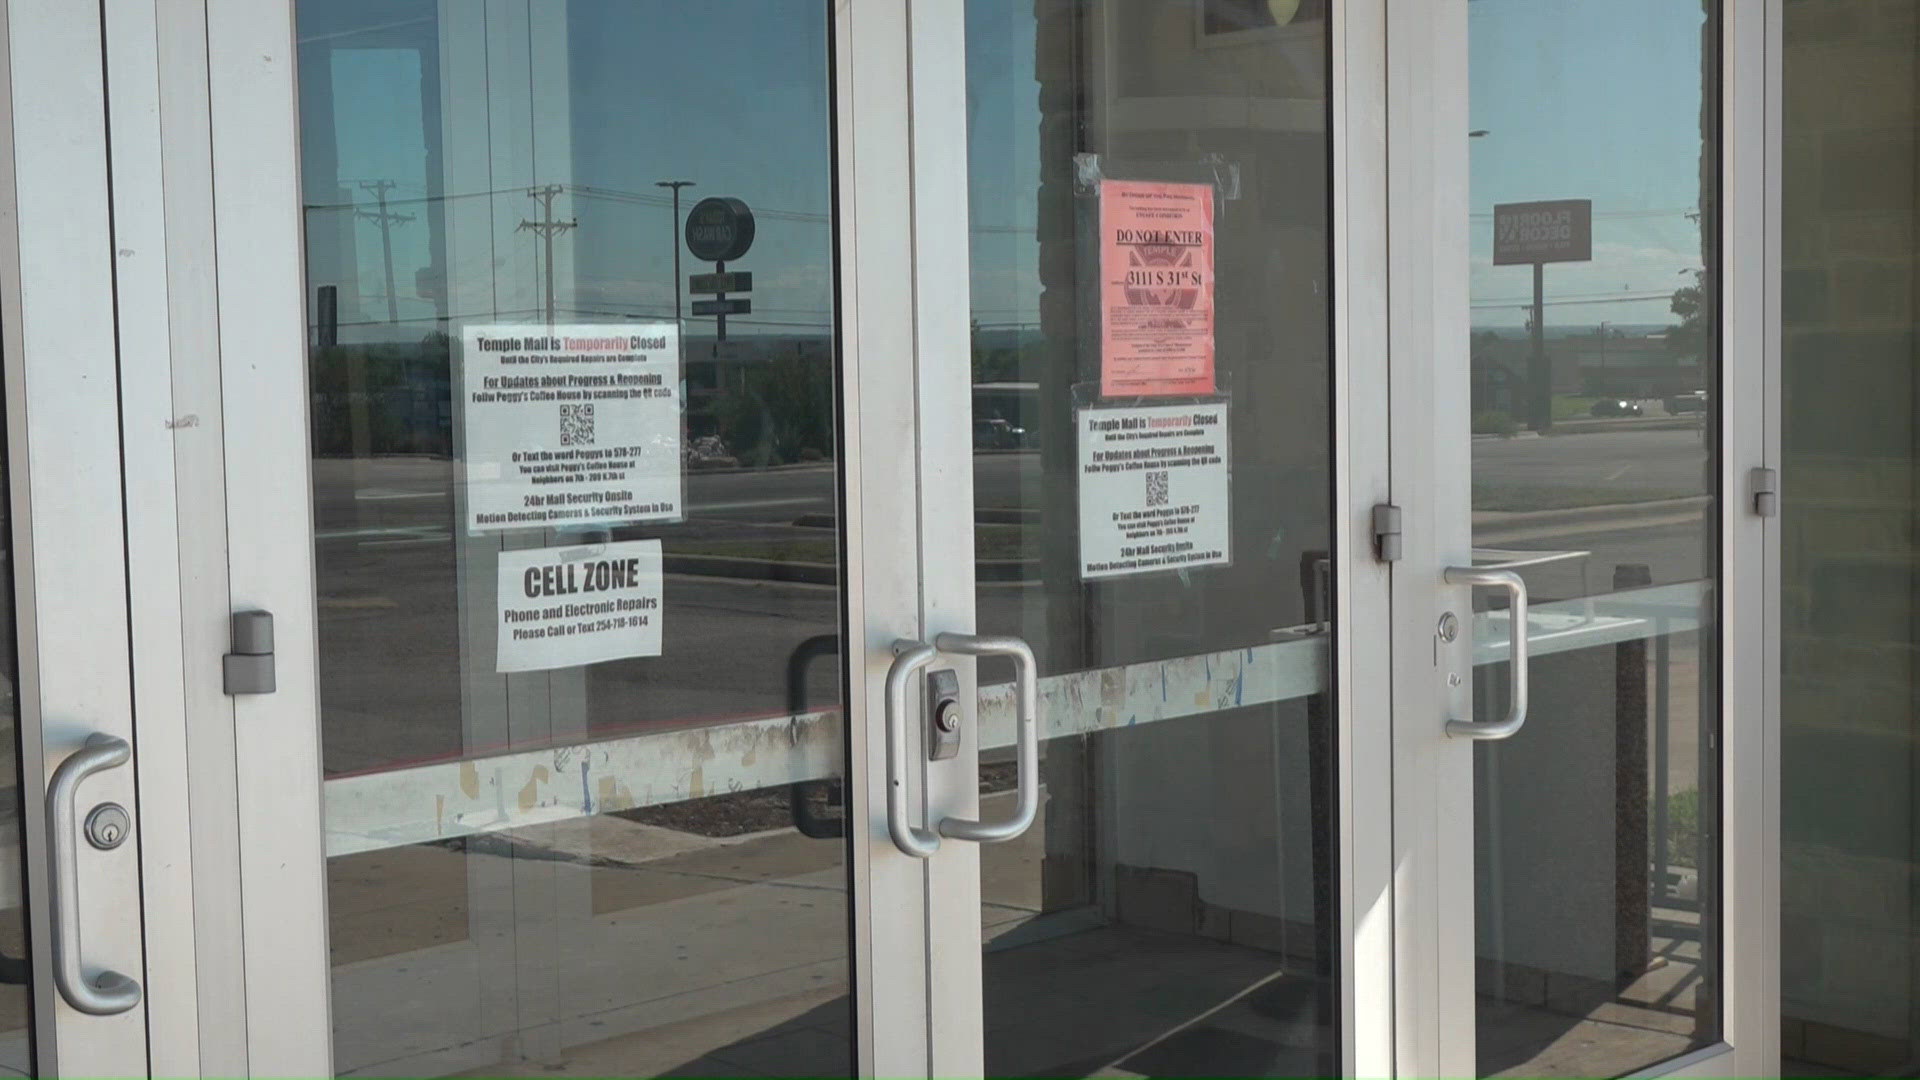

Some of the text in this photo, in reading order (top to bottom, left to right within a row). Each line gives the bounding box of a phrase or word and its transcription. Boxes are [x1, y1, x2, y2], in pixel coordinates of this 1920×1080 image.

[1116, 229, 1202, 243] DO NOT ENTER
[1129, 270, 1152, 285] 3111
[1157, 271, 1163, 285] S
[1168, 271, 1188, 285] 31st
[477, 336, 666, 353] Temple Mall is Temporarily Closed
[501, 355, 516, 364] Until
[518, 354, 529, 364] the
[530, 354, 548, 364] City's
[550, 354, 579, 364] Required
[581, 354, 605, 363] Repairs
[618, 353, 647, 363] Complete
[484, 373, 662, 388] For Updates about Progress & Reopening
[497, 391, 528, 403] Peggy's
[530, 390, 555, 401] Coffee
[557, 389, 582, 400] House
[583, 389, 592, 400] by
[593, 388, 628, 400] scanning
[630, 388, 641, 398] the
[654, 387, 671, 398] code
[1089, 414, 1218, 432] Temple Mall is Temporarily Closed
[512, 452, 521, 462] Or
[523, 451, 539, 461] Text
[541, 451, 553, 460] the
[554, 450, 574, 460] word
[575, 449, 603, 460] Peggys
[605, 448, 612, 458] to
[1093, 451, 1104, 461] For
[1105, 450, 1132, 460] Updates
[1133, 449, 1150, 458] about
[1151, 447, 1176, 457] Progress
[519, 465, 531, 474] You
[533, 465, 544, 473] can
[546, 464, 559, 472] visit
[586, 462, 607, 471] Coffee
[1161, 460, 1166, 468] by
[524, 490, 633, 507] 24hr Mall Security Onsite
[476, 502, 673, 524] Motion Detecting Cameras & Security System in Use
[1113, 512, 1119, 520] Or
[1120, 512, 1132, 520] Text
[1143, 510, 1155, 518] word
[1121, 547, 1135, 557] 24hr
[1137, 545, 1150, 556] Mall
[1151, 543, 1174, 553] Security
[1087, 563, 1108, 572] Motion
[1109, 560, 1136, 570] Detecting
[1167, 554, 1186, 563] Security
[524, 558, 639, 598] CELL ZONE
[504, 596, 657, 623] Phone and Electronic Repairs
[513, 616, 648, 640] Please Call or Text 254-718-1614
